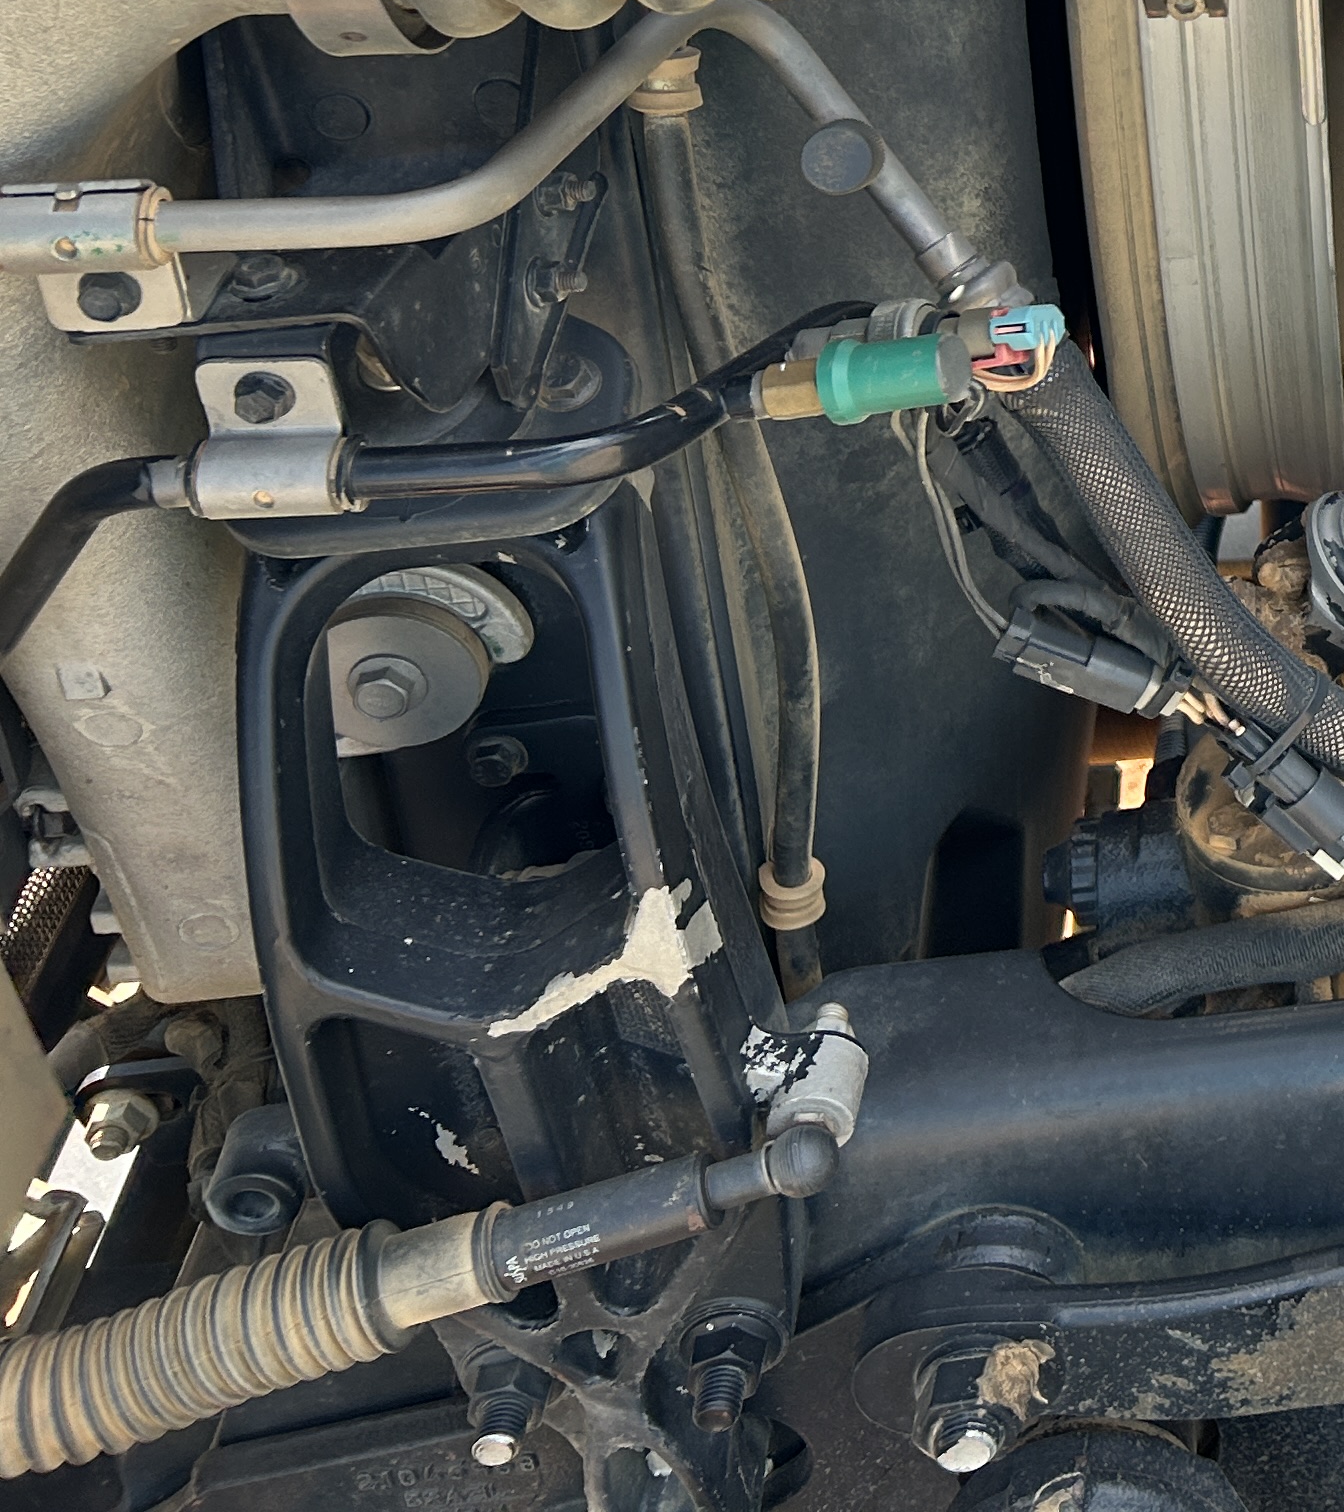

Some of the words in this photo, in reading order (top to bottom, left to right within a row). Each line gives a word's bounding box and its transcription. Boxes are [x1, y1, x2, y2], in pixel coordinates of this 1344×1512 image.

[524, 1239, 540, 1251] DO
[541, 1232, 562, 1245] NOT
[563, 1223, 591, 1239] OPEN
[524, 1251, 549, 1264] HIGH
[549, 1233, 601, 1256] PRESSURE
[533, 1258, 560, 1272] MADE
[562, 1254, 573, 1263] IN
